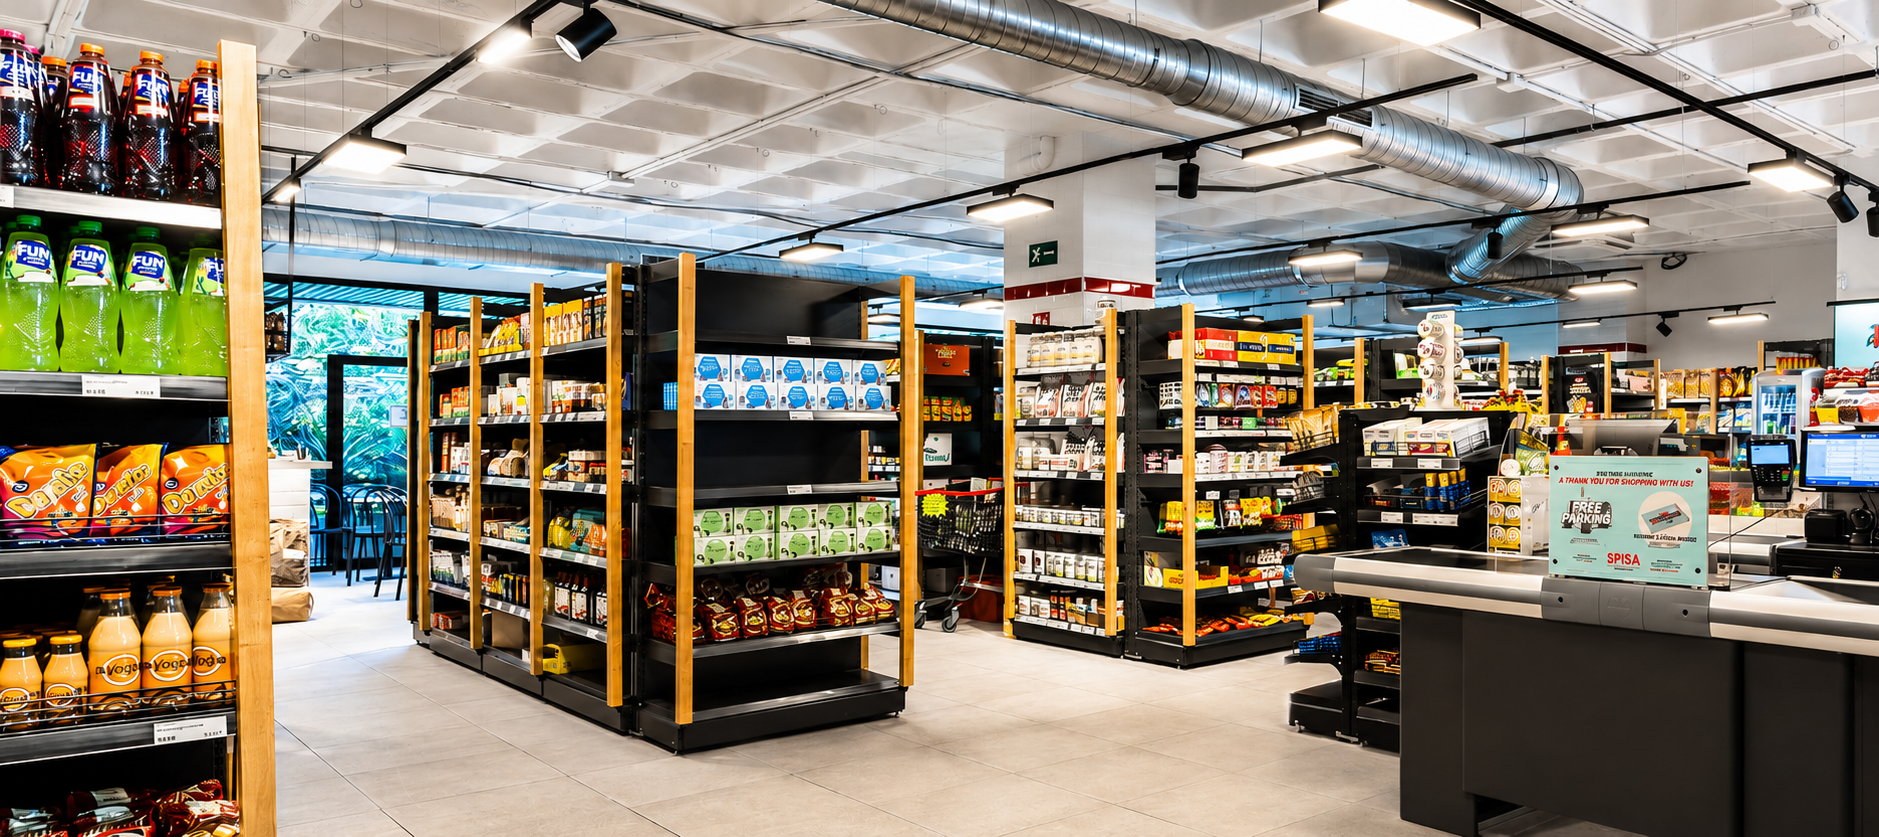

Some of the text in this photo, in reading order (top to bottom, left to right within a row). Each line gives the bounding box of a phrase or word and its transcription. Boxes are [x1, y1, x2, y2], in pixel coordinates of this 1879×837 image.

[17, 243, 50, 260] FUN
[73, 250, 105, 265] FUN
[132, 255, 163, 270] FUN
[1565, 477, 1589, 485] THANK
[1590, 477, 1604, 485] YOU
[1605, 478, 1620, 486] FOR
[1680, 480, 1694, 488] US!
[1572, 501, 1603, 514] FREE
[1561, 512, 1611, 525] PARKING
[1607, 552, 1641, 566] SPISA
